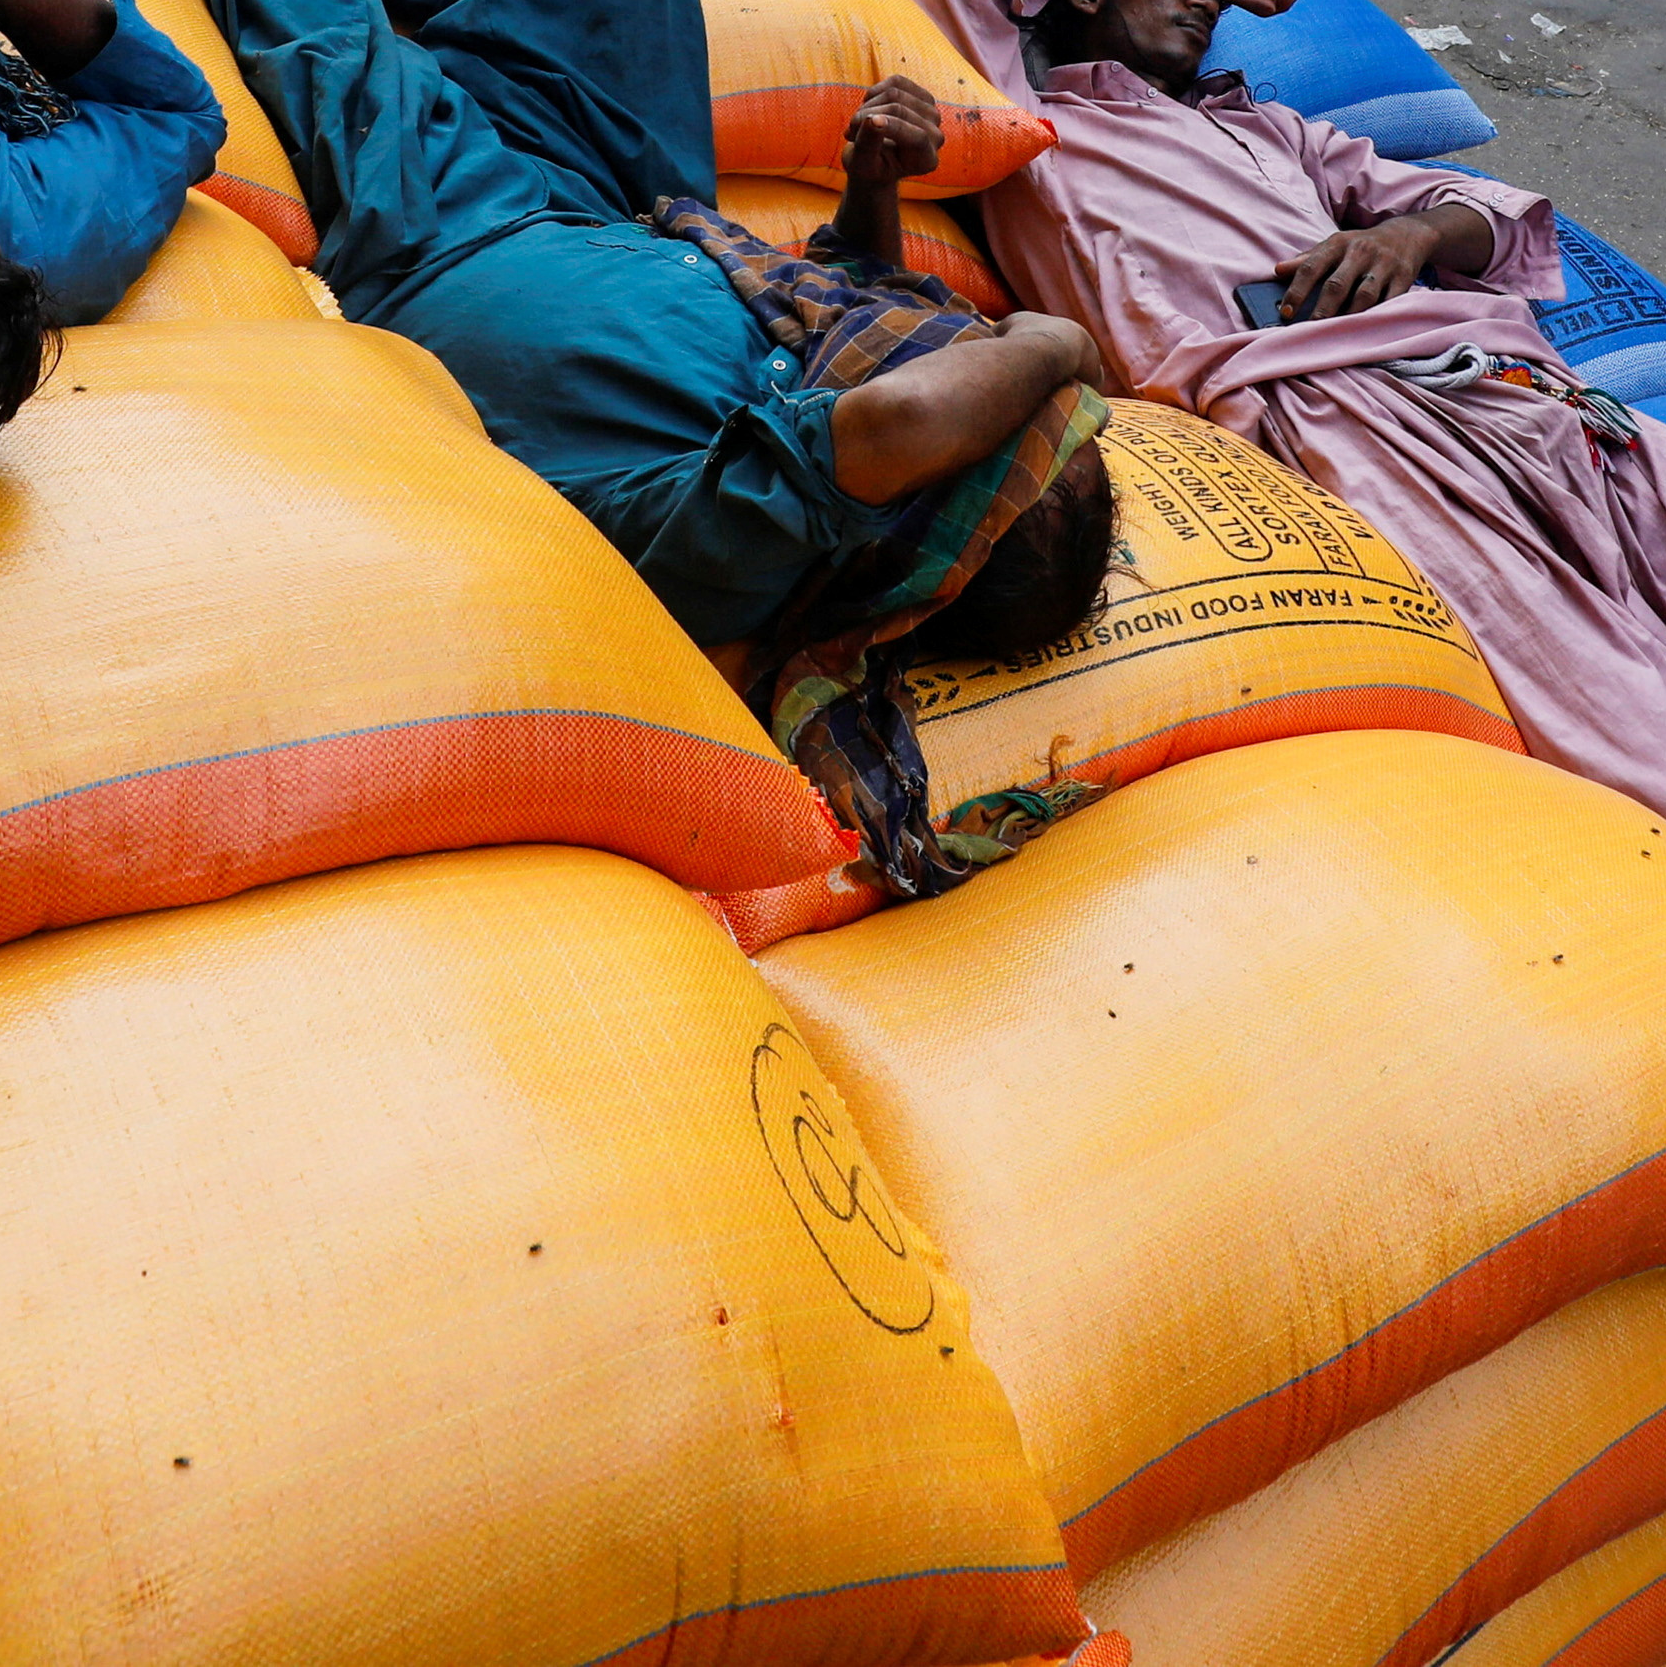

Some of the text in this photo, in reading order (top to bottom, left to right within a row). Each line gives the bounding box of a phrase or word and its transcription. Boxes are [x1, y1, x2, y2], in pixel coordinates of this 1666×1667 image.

[1142, 446, 1178, 466] OF
[1133, 481, 1200, 541] WEIGHT
[1169, 466, 1229, 516] KINDS
[1211, 468, 1301, 546] SORTEX
[1217, 510, 1261, 551] ALL
[1004, 586, 1353, 675] FARAN FOOD INDUSTRIES
